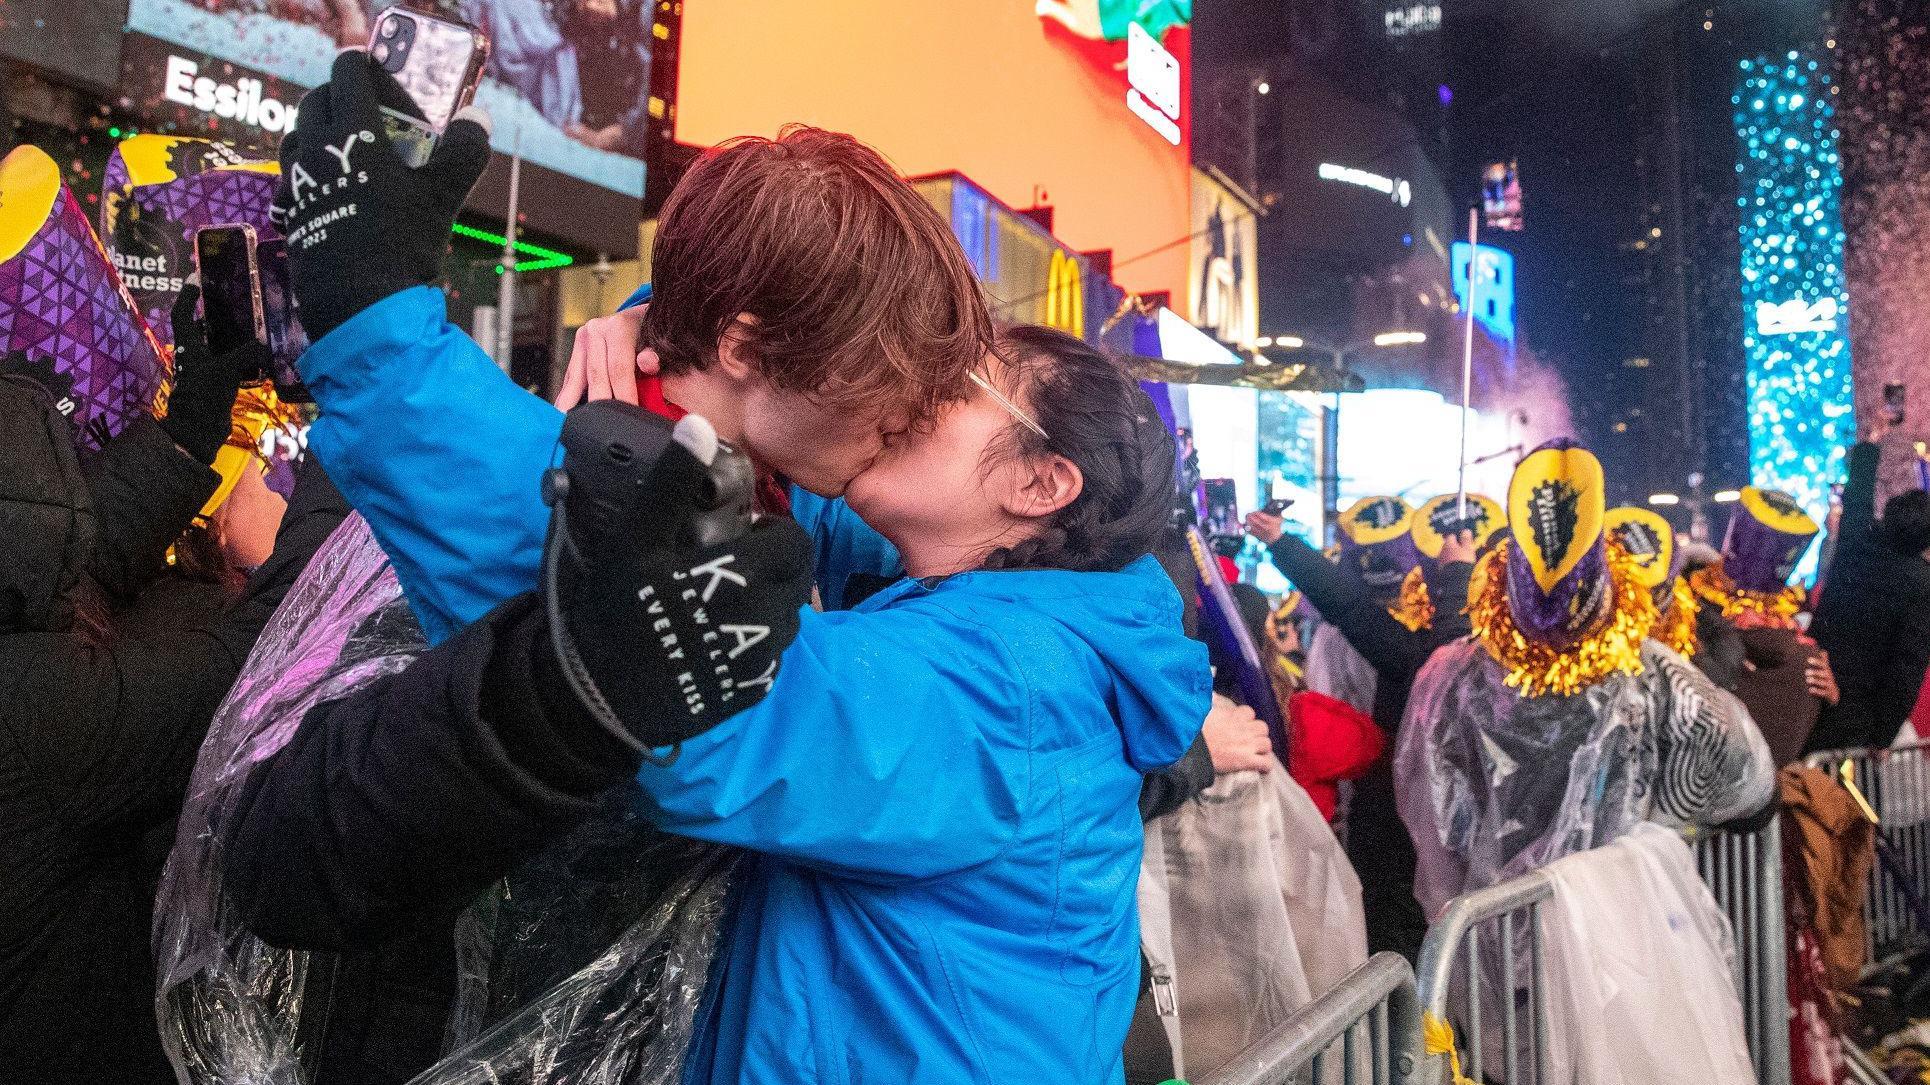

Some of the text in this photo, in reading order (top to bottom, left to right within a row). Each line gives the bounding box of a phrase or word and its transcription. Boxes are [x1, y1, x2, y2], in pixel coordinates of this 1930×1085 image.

[106, 245, 167, 272] lanet
[308, 203, 358, 231] SQUARE
[638, 585, 705, 715] EVERY KISS
[672, 570, 735, 702] JEWELERS
[690, 554, 777, 693] KAY
